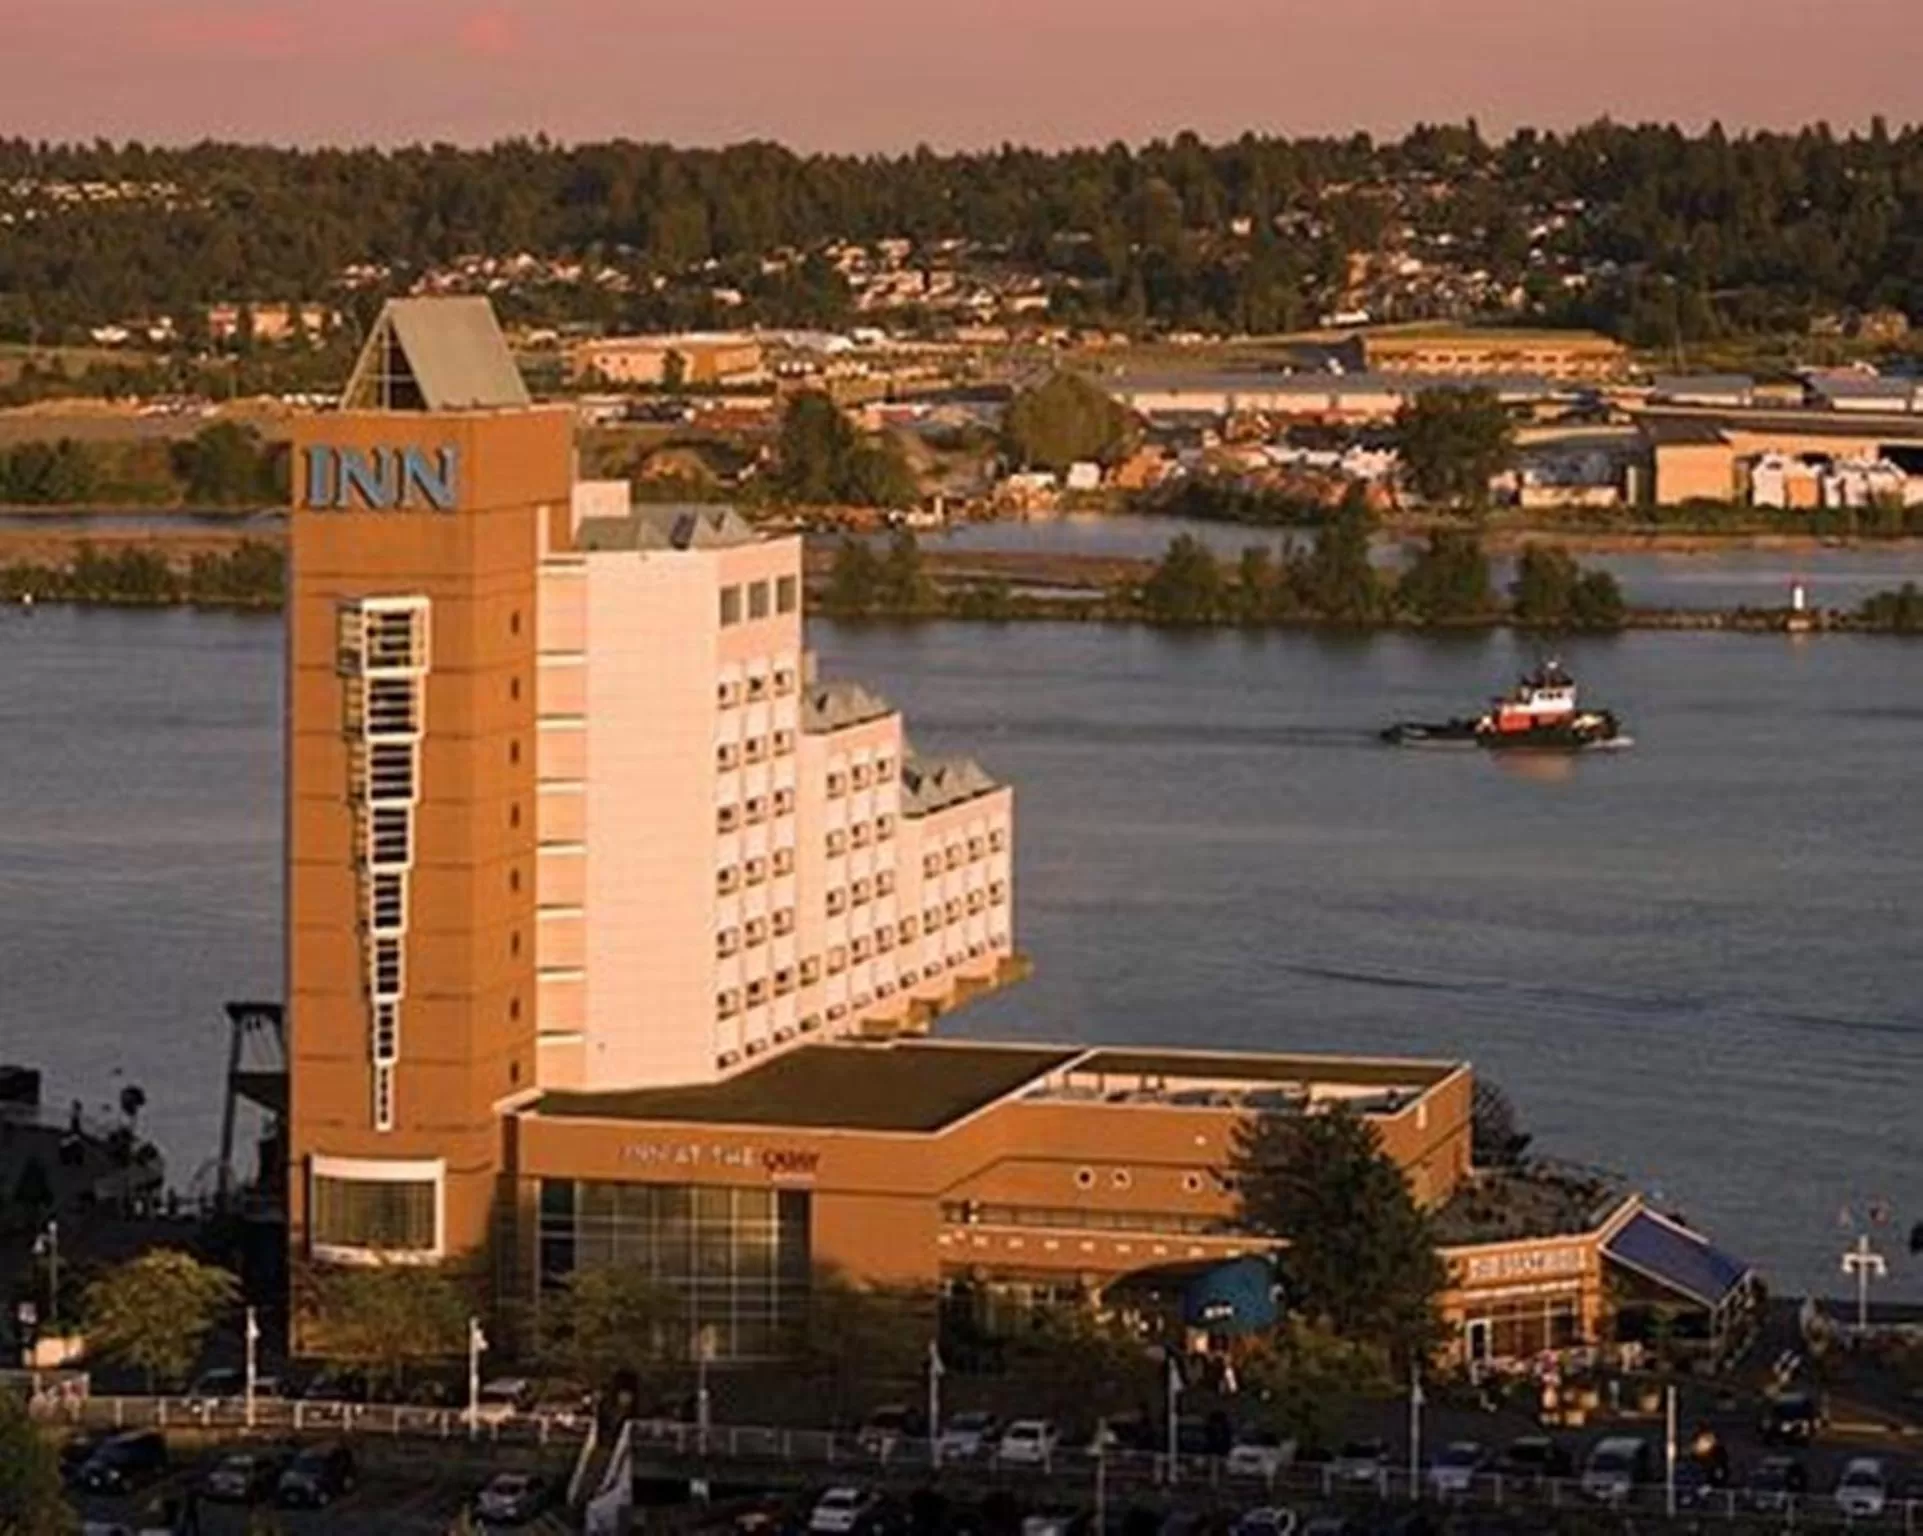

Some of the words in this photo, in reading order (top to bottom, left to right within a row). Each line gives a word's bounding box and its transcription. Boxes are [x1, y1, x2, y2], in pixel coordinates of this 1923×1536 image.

[304, 442, 458, 510] INN
[673, 1144, 700, 1166] AT
[710, 1146, 753, 1168] THE
